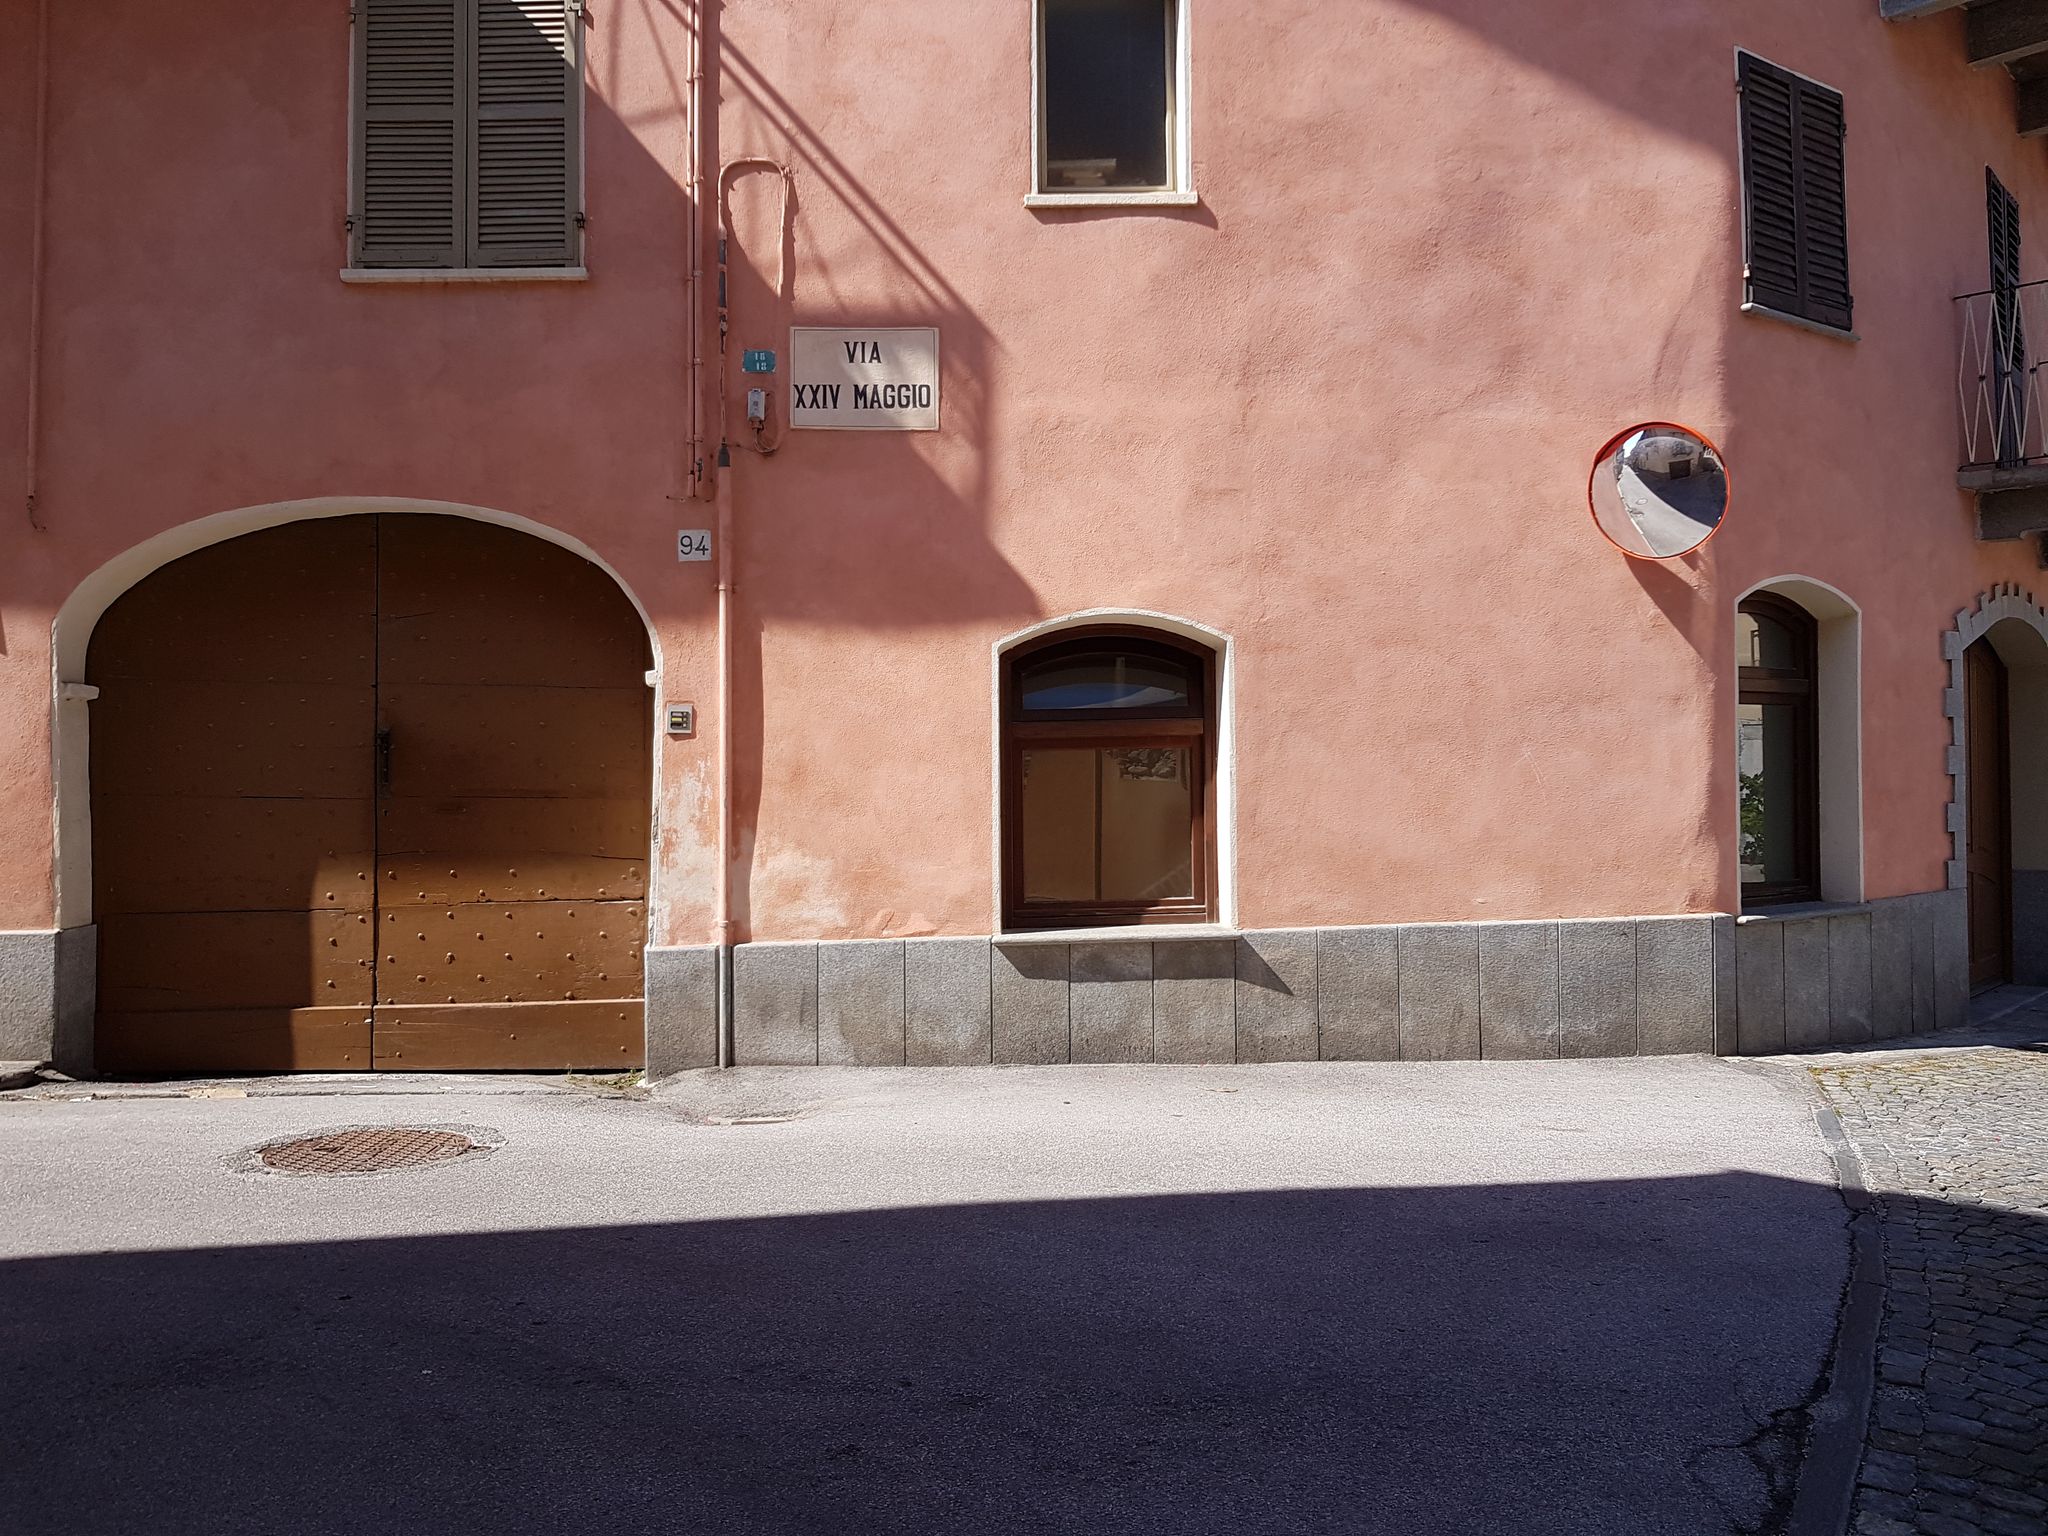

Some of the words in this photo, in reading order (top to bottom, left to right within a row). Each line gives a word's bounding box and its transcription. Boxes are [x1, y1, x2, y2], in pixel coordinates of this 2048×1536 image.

[844, 341, 882, 364] VIA
[793, 384, 841, 409] XXIV
[853, 384, 931, 409] MAGGIO
[680, 535, 709, 556] 94
